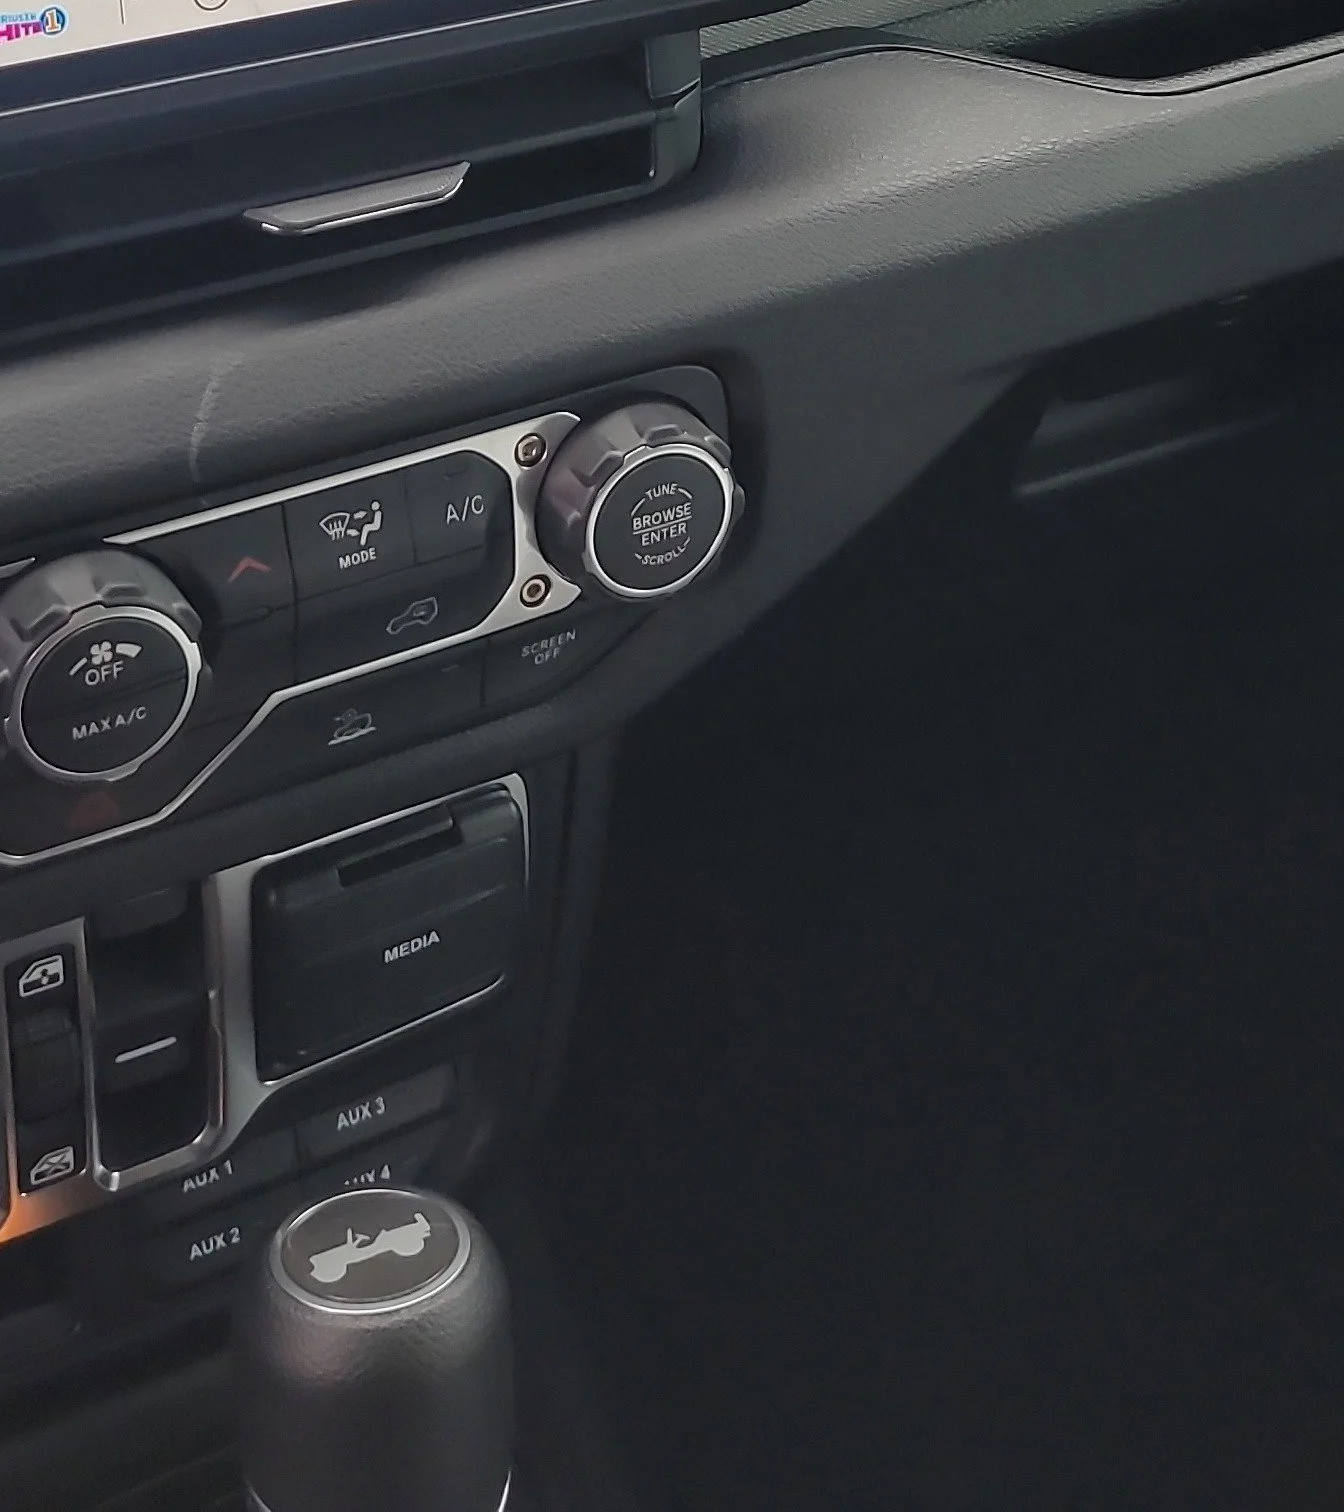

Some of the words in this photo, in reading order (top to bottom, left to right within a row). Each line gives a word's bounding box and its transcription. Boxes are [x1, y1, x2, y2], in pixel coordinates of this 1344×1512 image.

[645, 483, 678, 500] TUNE
[445, 494, 486, 525] A/C
[632, 502, 692, 530] BROWSE
[641, 522, 687, 546] ENTER
[338, 548, 378, 570] MODE
[641, 545, 686, 565] SCROLL
[521, 629, 577, 658] SCREEN
[533, 647, 562, 666] OFF
[84, 660, 126, 686] OFF
[72, 716, 112, 740] MAX
[114, 705, 148, 728] A/C
[383, 929, 441, 965] MEDIA
[336, 1101, 372, 1131] AUX
[375, 1096, 386, 1115] 3
[183, 1167, 220, 1193] AUX
[189, 1232, 227, 1262] AUX
[229, 1227, 241, 1245] 2
